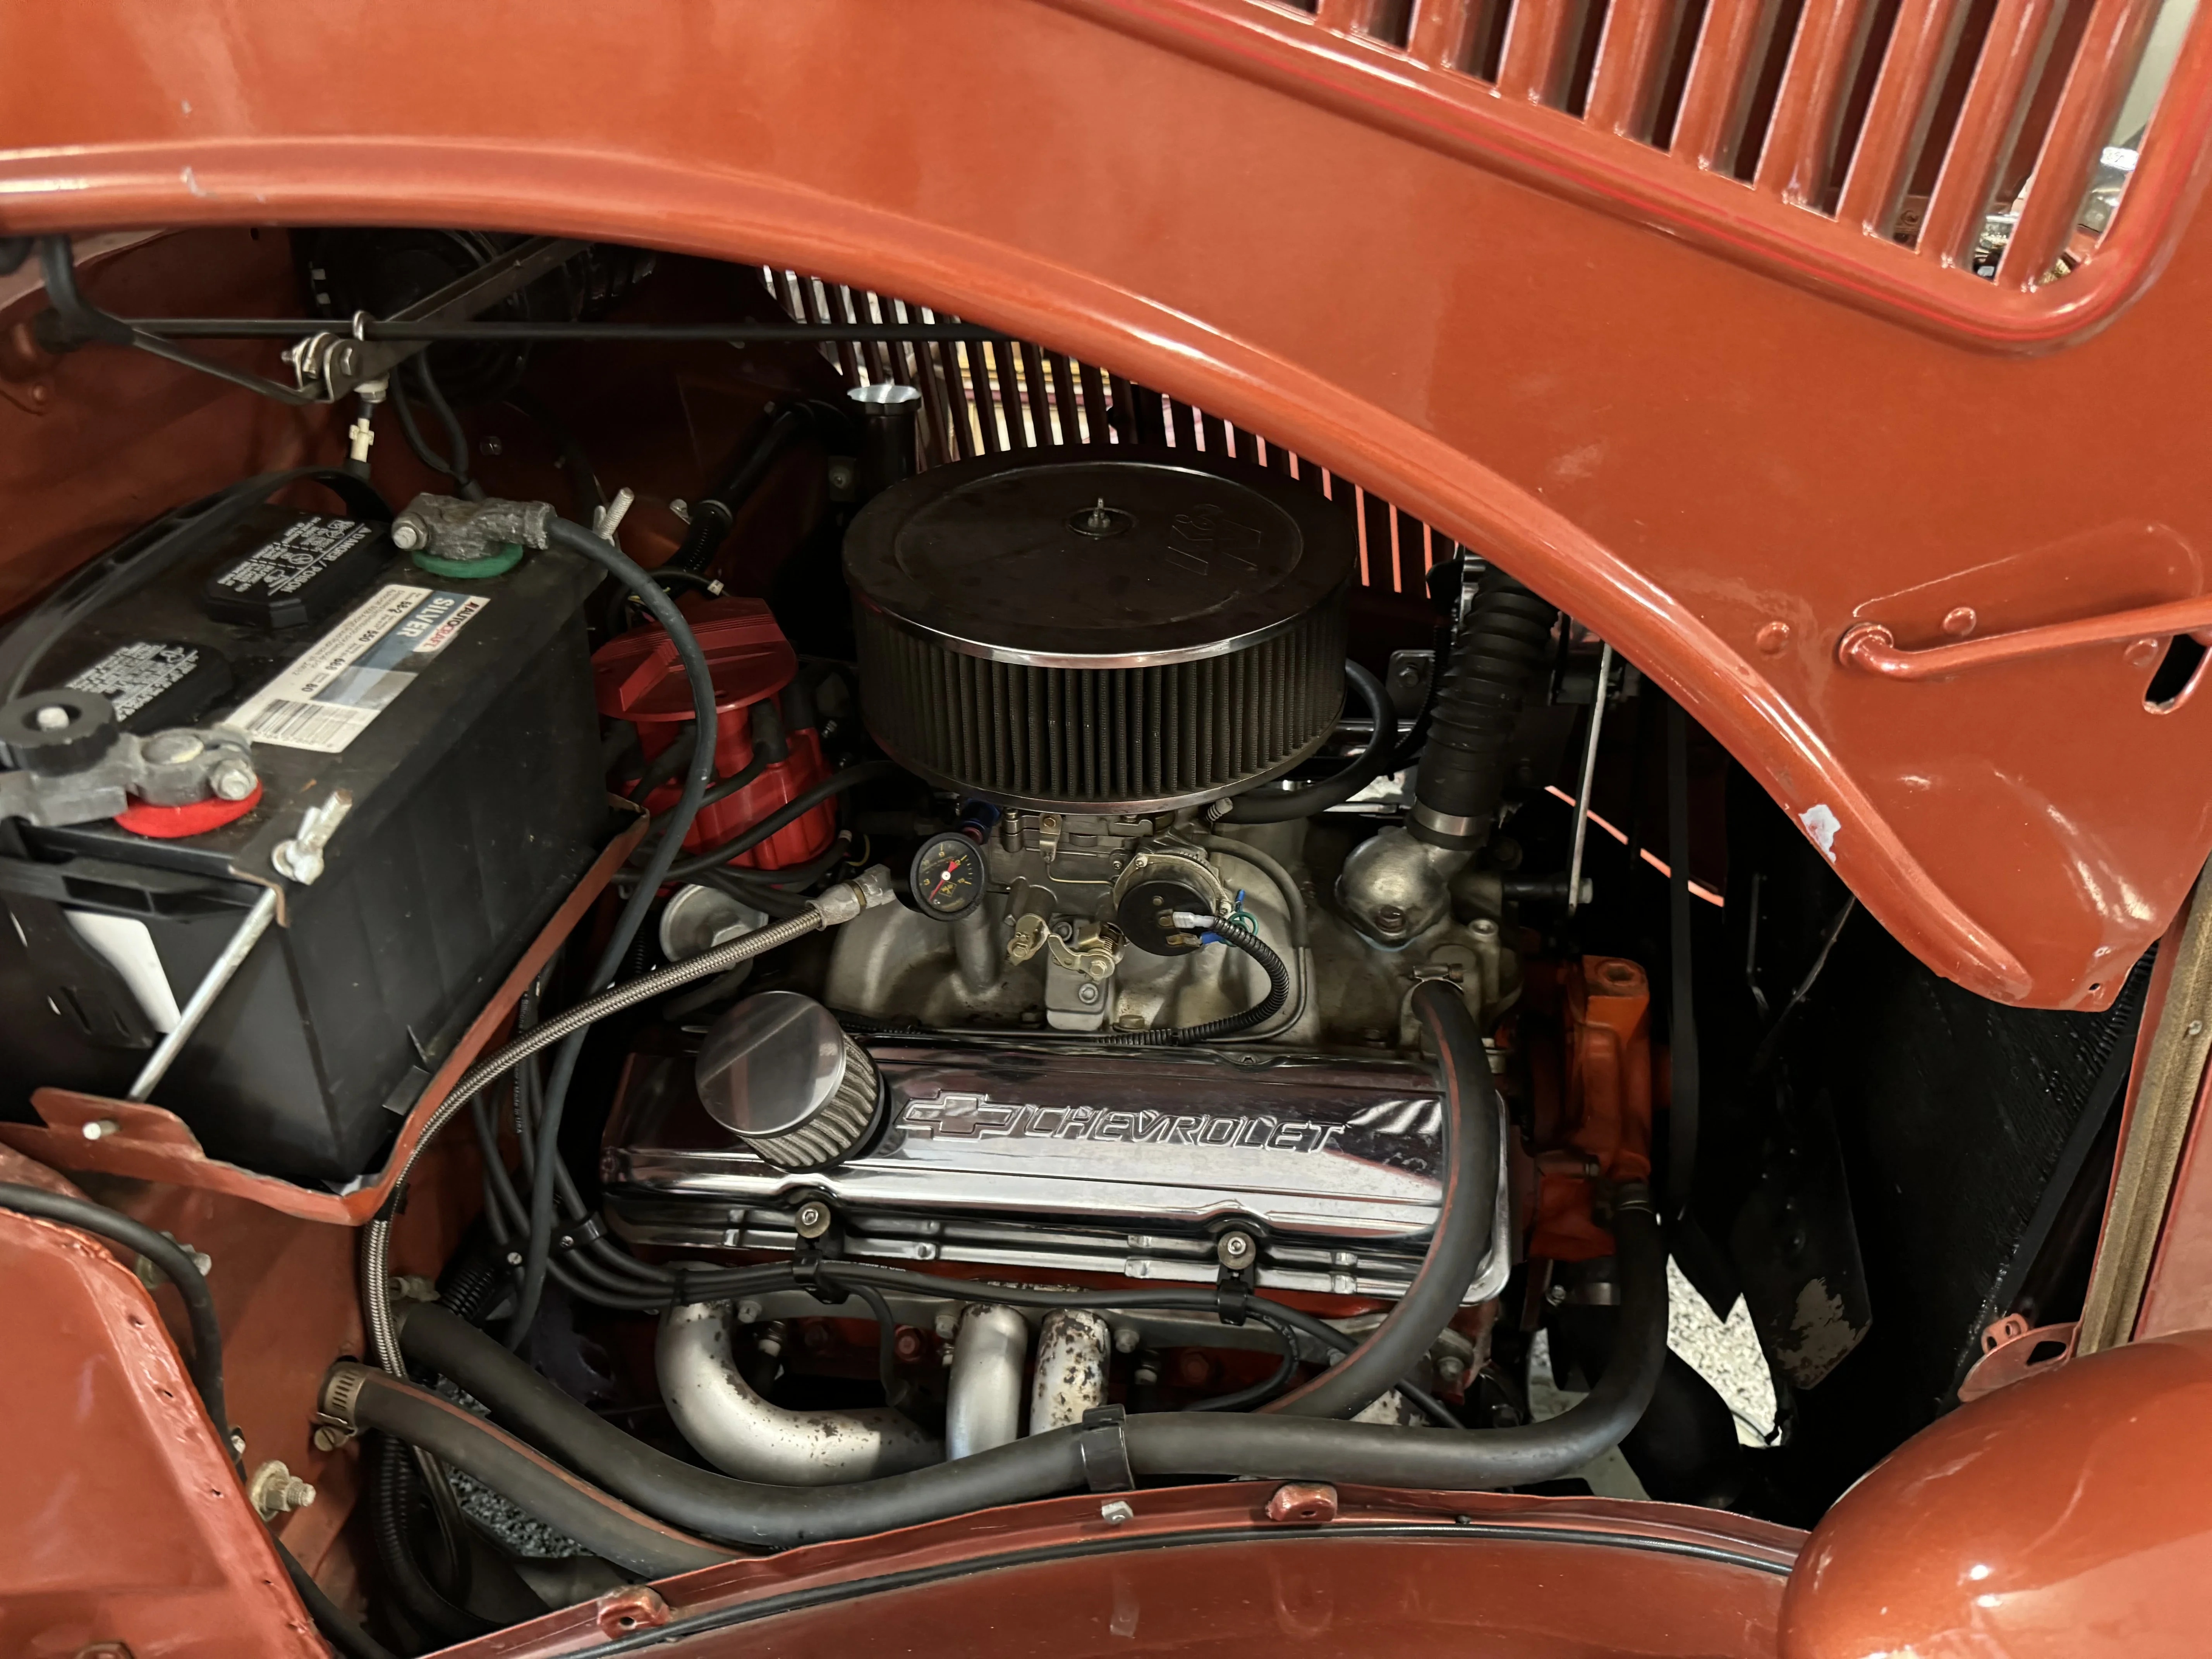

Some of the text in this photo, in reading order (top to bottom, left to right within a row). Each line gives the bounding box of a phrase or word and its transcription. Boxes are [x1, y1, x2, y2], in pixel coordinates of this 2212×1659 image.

[325, 534, 365, 561] DANGER
[280, 566, 323, 592] POISON
[396, 598, 455, 637] SILVER
[359, 630, 379, 642] 550
[301, 683, 318, 692] 80
[1024, 1104, 1347, 1153] CHEVROLET
